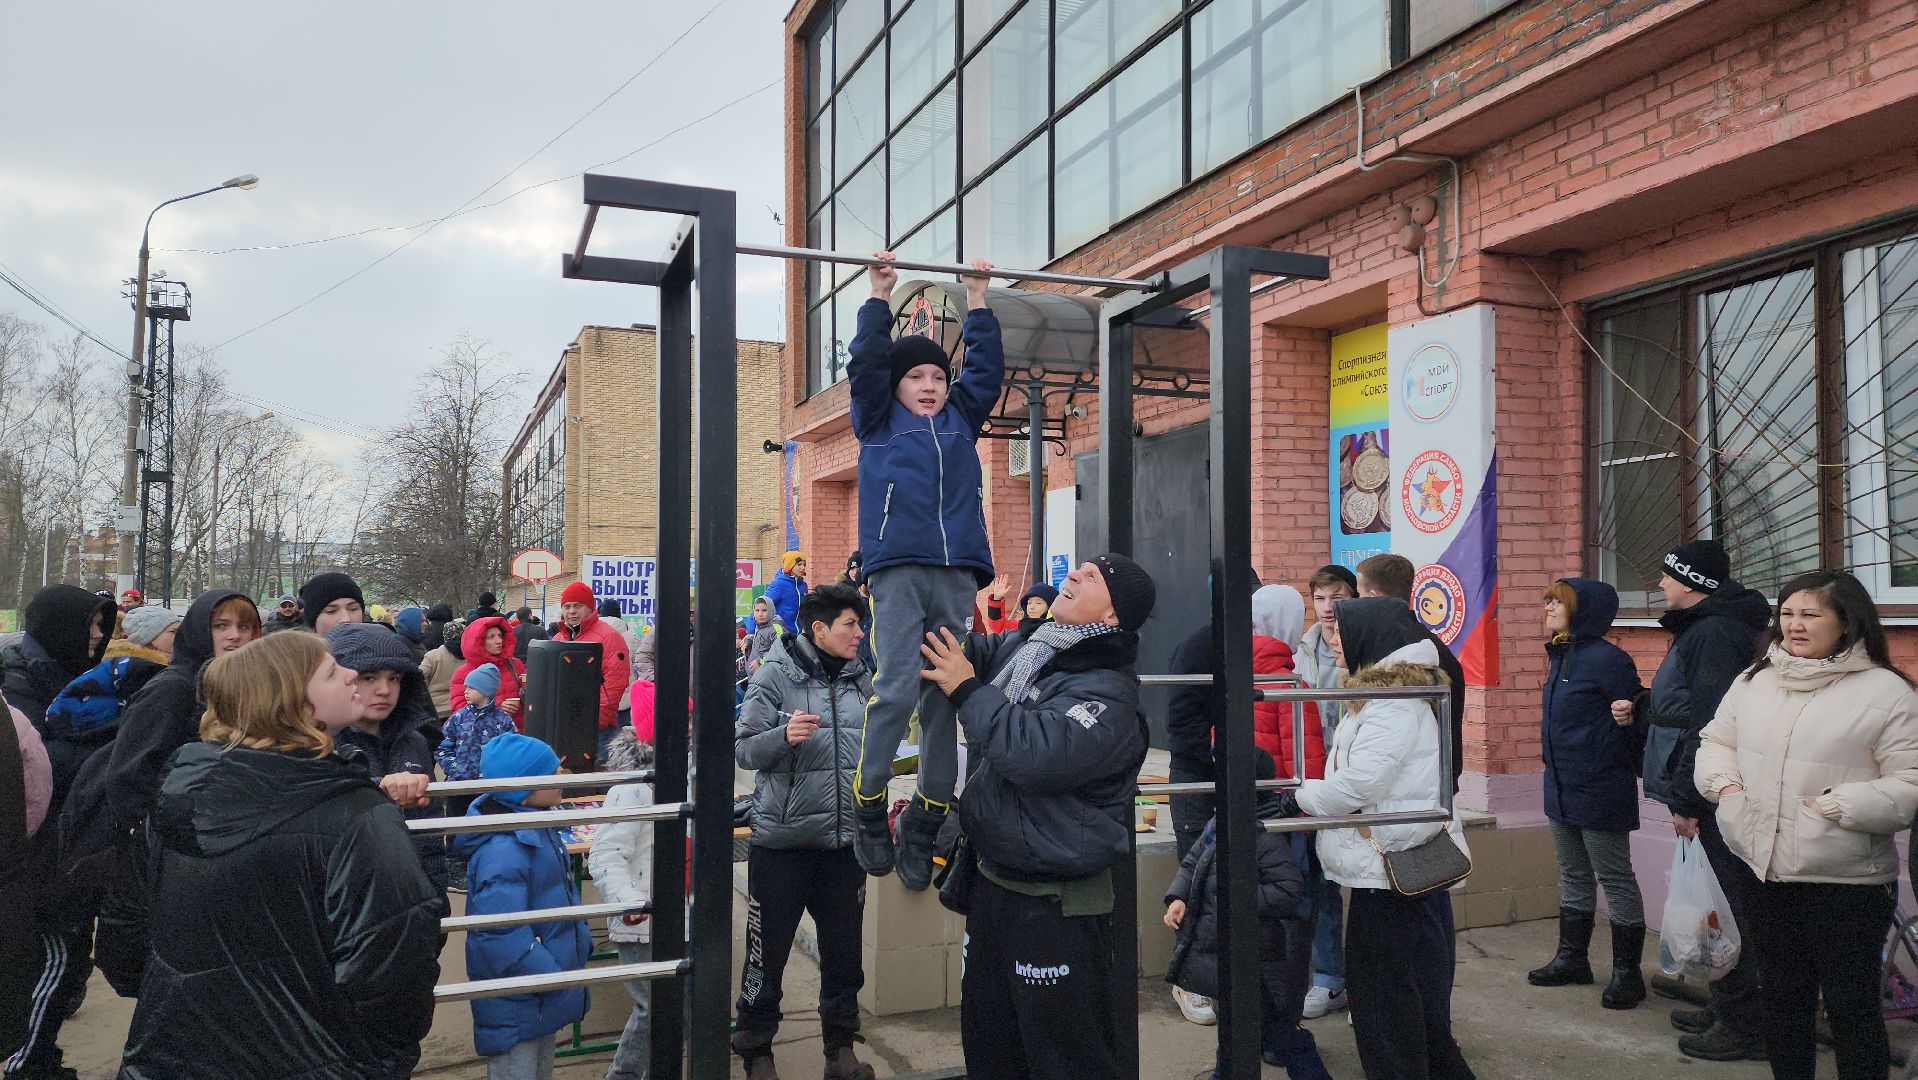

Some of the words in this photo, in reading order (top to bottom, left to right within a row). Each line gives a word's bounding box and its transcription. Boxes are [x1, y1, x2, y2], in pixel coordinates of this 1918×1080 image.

[1425, 381, 1453, 397] СПОРТ
[1404, 452, 1440, 486] ФЕДЕРАЦИЯ
[1440, 454, 1461, 480] САМБО
[592, 560, 656, 578] БЫСТР
[592, 579, 650, 597] ВЫШЕ
[1440, 571, 1461, 597] ДЗЮДО
[748, 894, 763, 967] ATHLETIC
